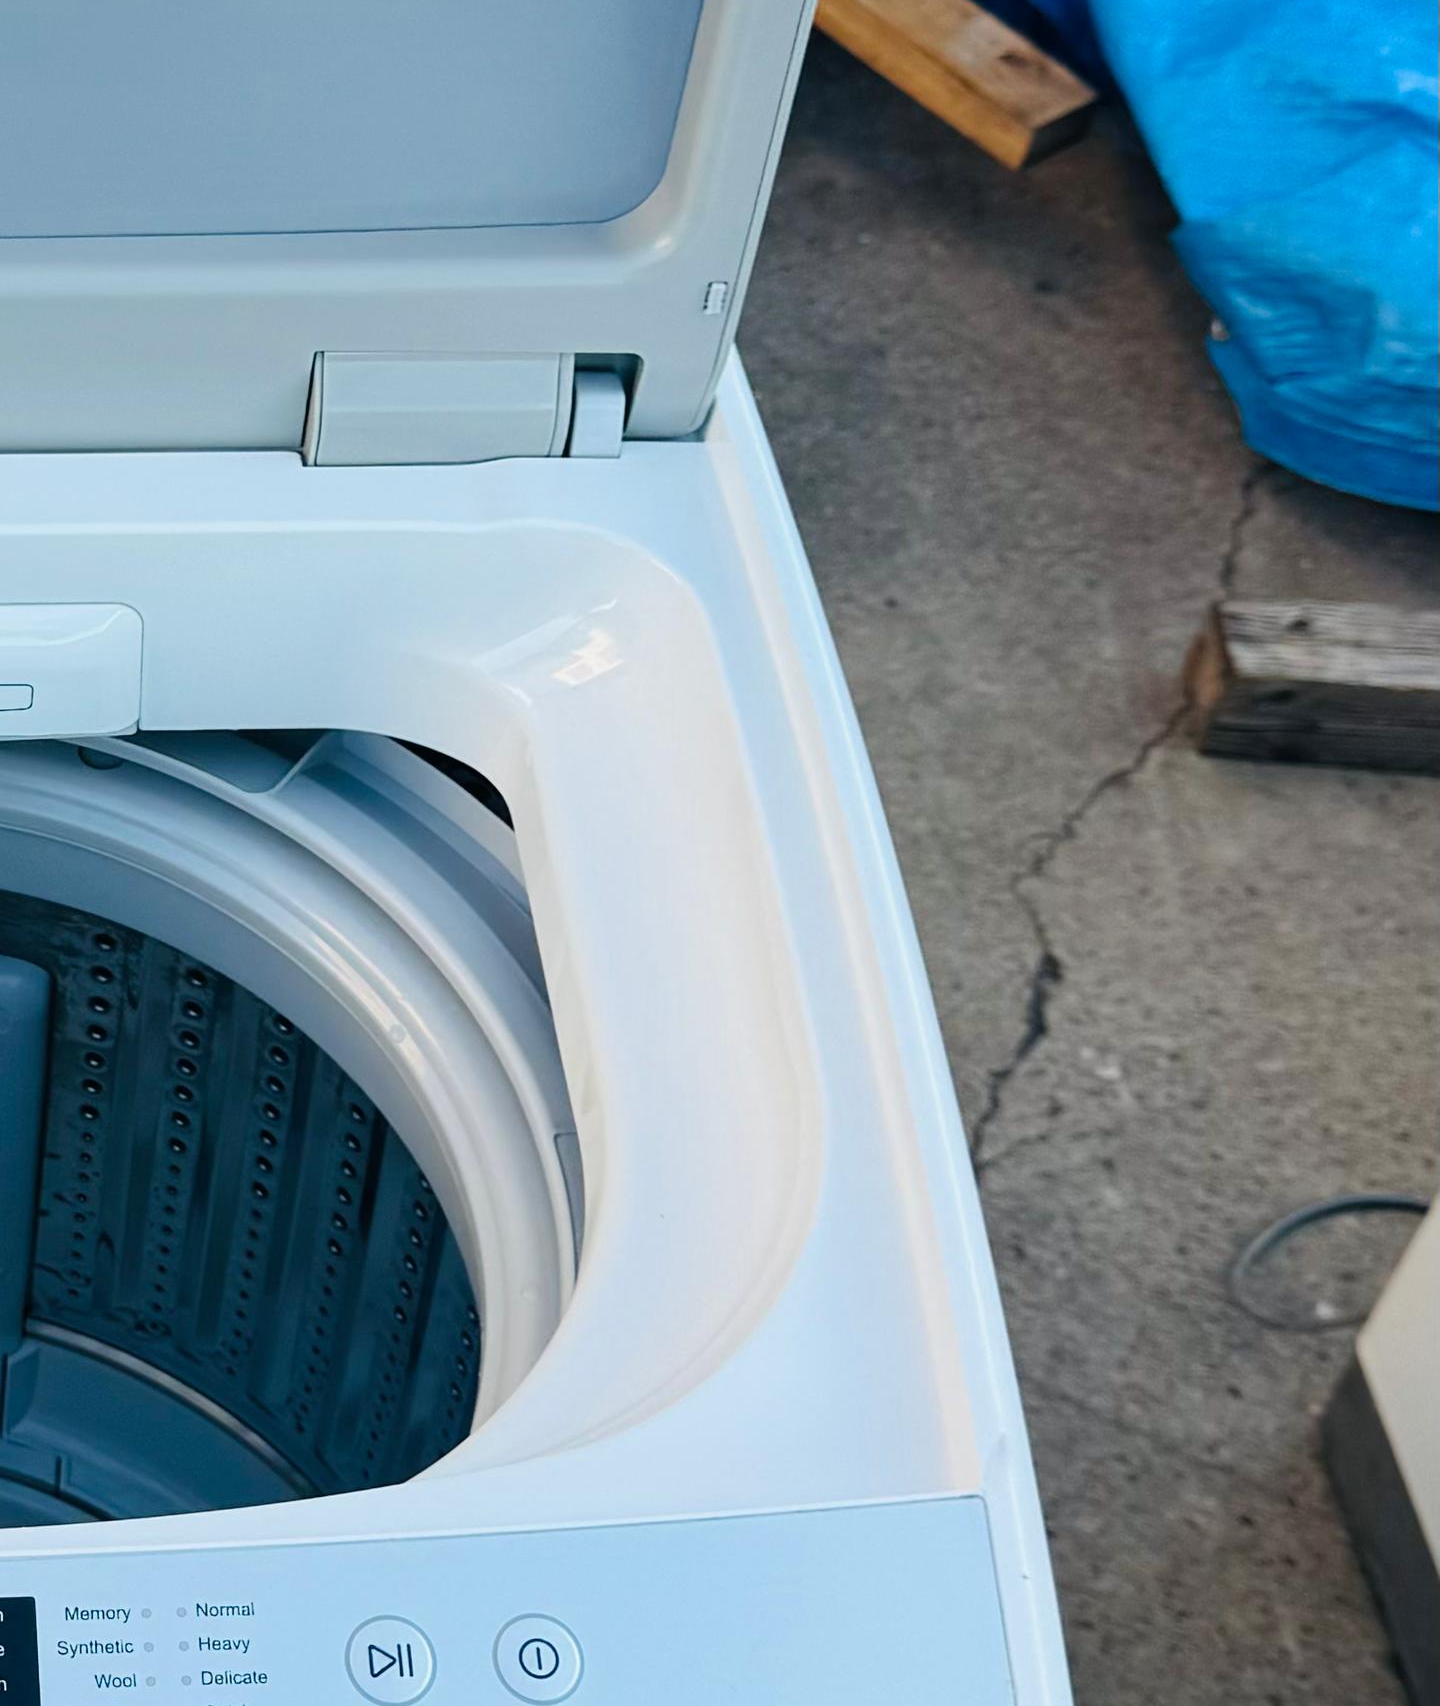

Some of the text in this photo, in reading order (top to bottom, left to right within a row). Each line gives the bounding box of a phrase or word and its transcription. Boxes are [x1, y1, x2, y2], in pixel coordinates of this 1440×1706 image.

[64, 1606, 131, 1624] Memory
[195, 1601, 255, 1617] Normal
[57, 1639, 134, 1659] Synthetic
[198, 1636, 250, 1654] Heavy
[94, 1673, 137, 1689] Wool
[201, 1670, 268, 1686] Delicate
